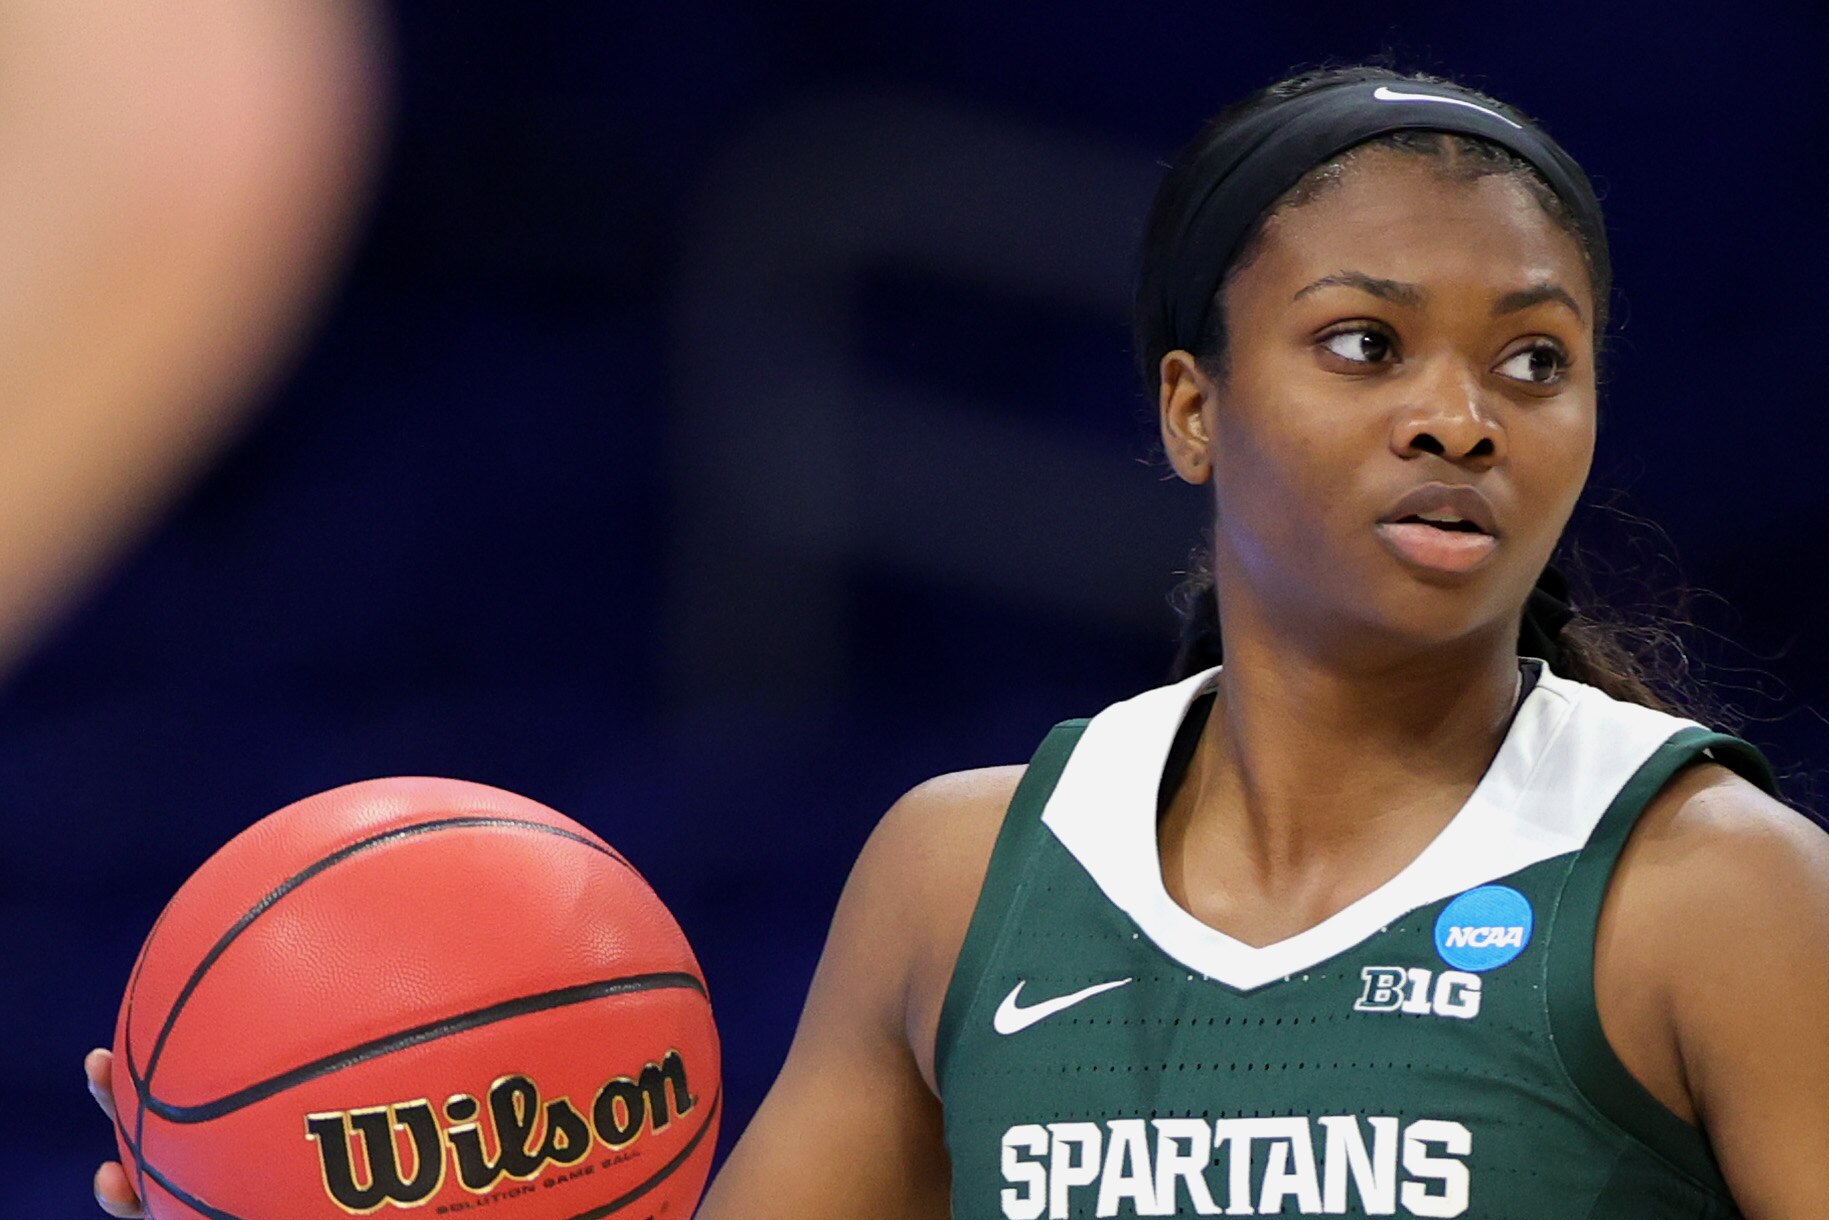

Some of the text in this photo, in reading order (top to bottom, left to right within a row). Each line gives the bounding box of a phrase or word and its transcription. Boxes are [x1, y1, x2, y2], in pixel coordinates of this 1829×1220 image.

[1445, 926, 1524, 948] NCAA
[305, 1048, 693, 1215] Wilson
[543, 1165, 595, 1188] GAME
[1000, 1114, 1472, 1220] SPARTANS
